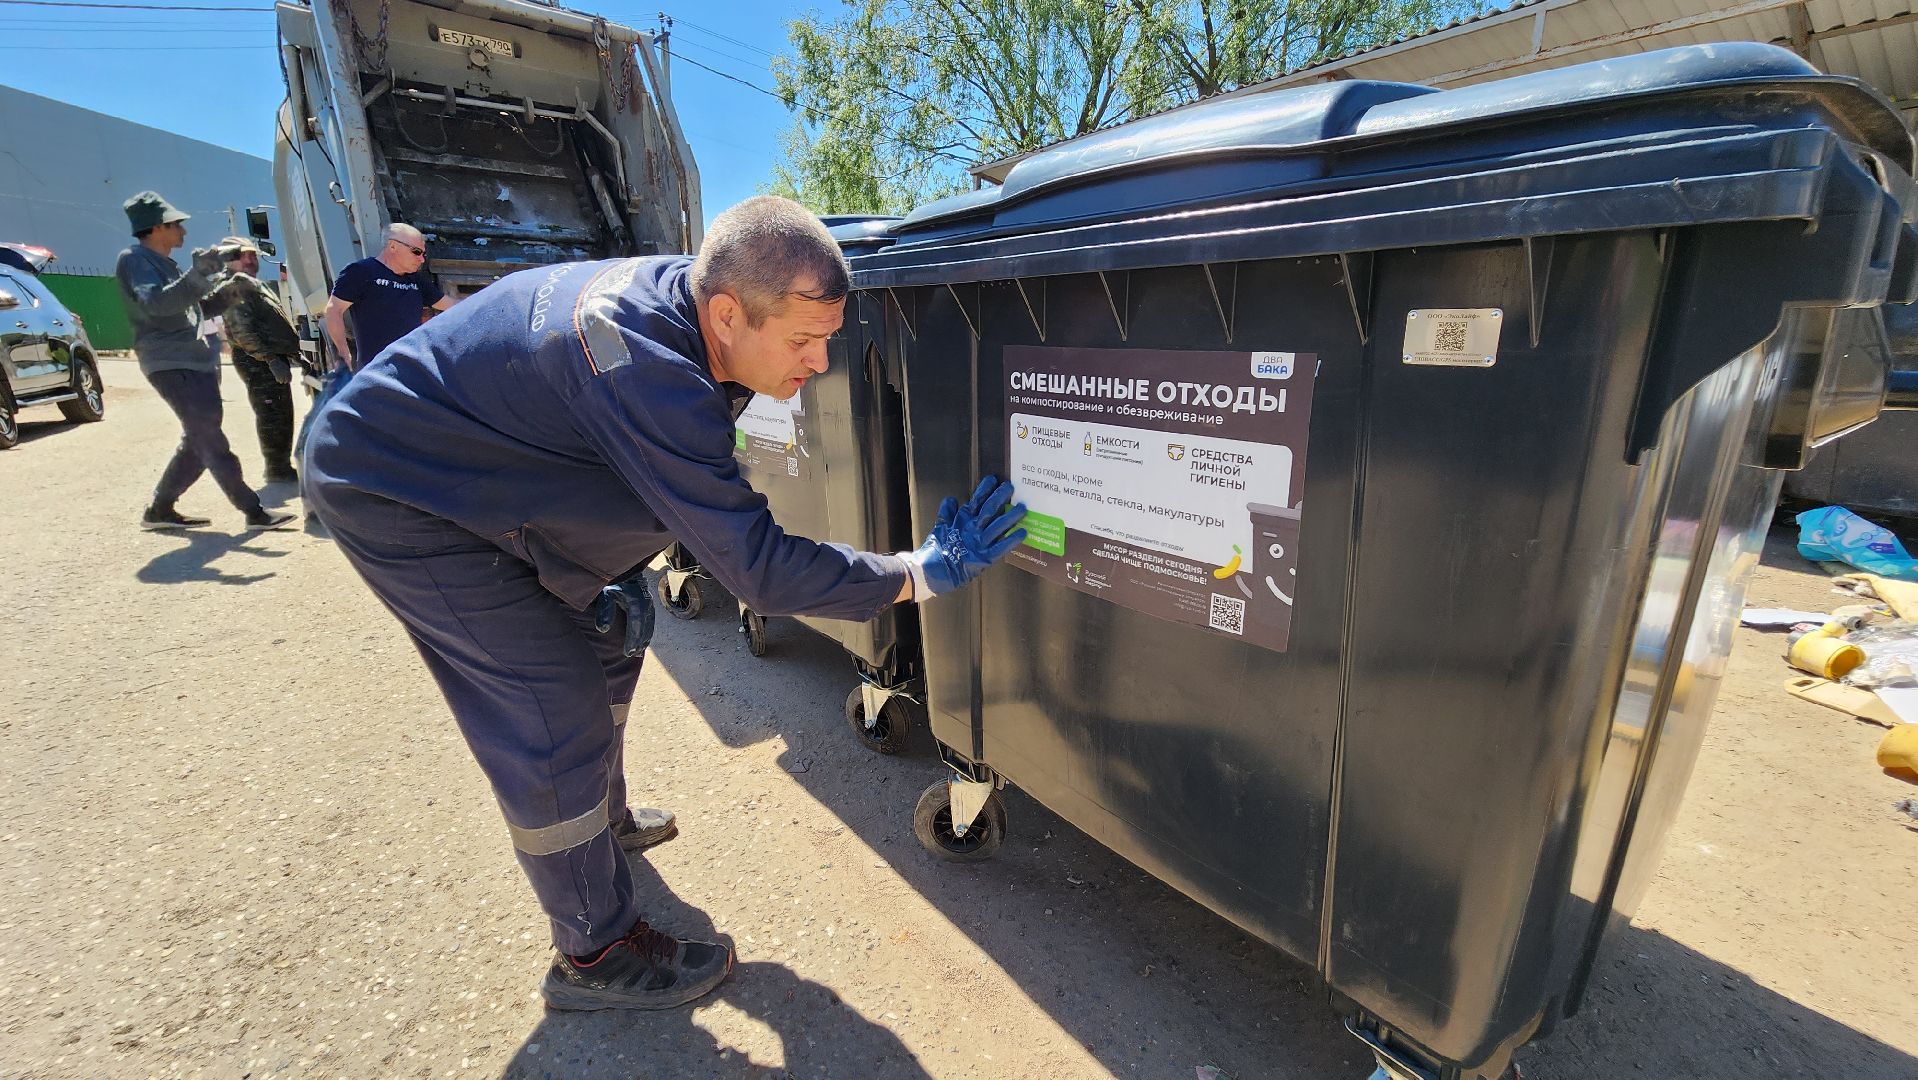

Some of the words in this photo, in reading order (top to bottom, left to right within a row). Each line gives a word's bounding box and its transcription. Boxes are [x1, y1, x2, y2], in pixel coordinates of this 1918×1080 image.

[1262, 355, 1283, 364] ДВА
[1257, 364, 1288, 375] БАКА
[1010, 371, 1150, 401] СМЕШАННЫЕ
[1156, 381, 1287, 415] ОТХОДЫ
[1010, 395, 1020, 403] на
[1021, 396, 1104, 412] компостирование
[1107, 405, 1113, 413] и
[1116, 404, 1224, 425] обезвреживание
[1032, 426, 1071, 440] ПИЩЕВЫЕ
[1031, 436, 1063, 449] ОТХОДЫ
[1096, 435, 1140, 450] ЕМКОСТИ
[1191, 448, 1254, 466] СРЕДСТВА
[1037, 467, 1070, 481] отходы,
[1072, 474, 1103, 487] кроме
[1190, 461, 1241, 477] ЛИЧНОЙ
[1190, 473, 1246, 491] ГИГИЕНЫ
[1022, 477, 1061, 494] пластика,
[1063, 488, 1104, 505] металла,
[1107, 495, 1146, 514] стекла,
[1148, 505, 1225, 528] макулатуры
[1092, 548, 1120, 562] СДЕЛАЙ
[1120, 555, 1142, 568] ЧИЩЕ
[1143, 562, 1207, 586] ПОДМОСКОВЬЕ!
[1103, 543, 1128, 554] МУСОР
[1128, 550, 1164, 565] РАЗДЕЛИ
[1165, 559, 1203, 575] СЕГОДНЯ
